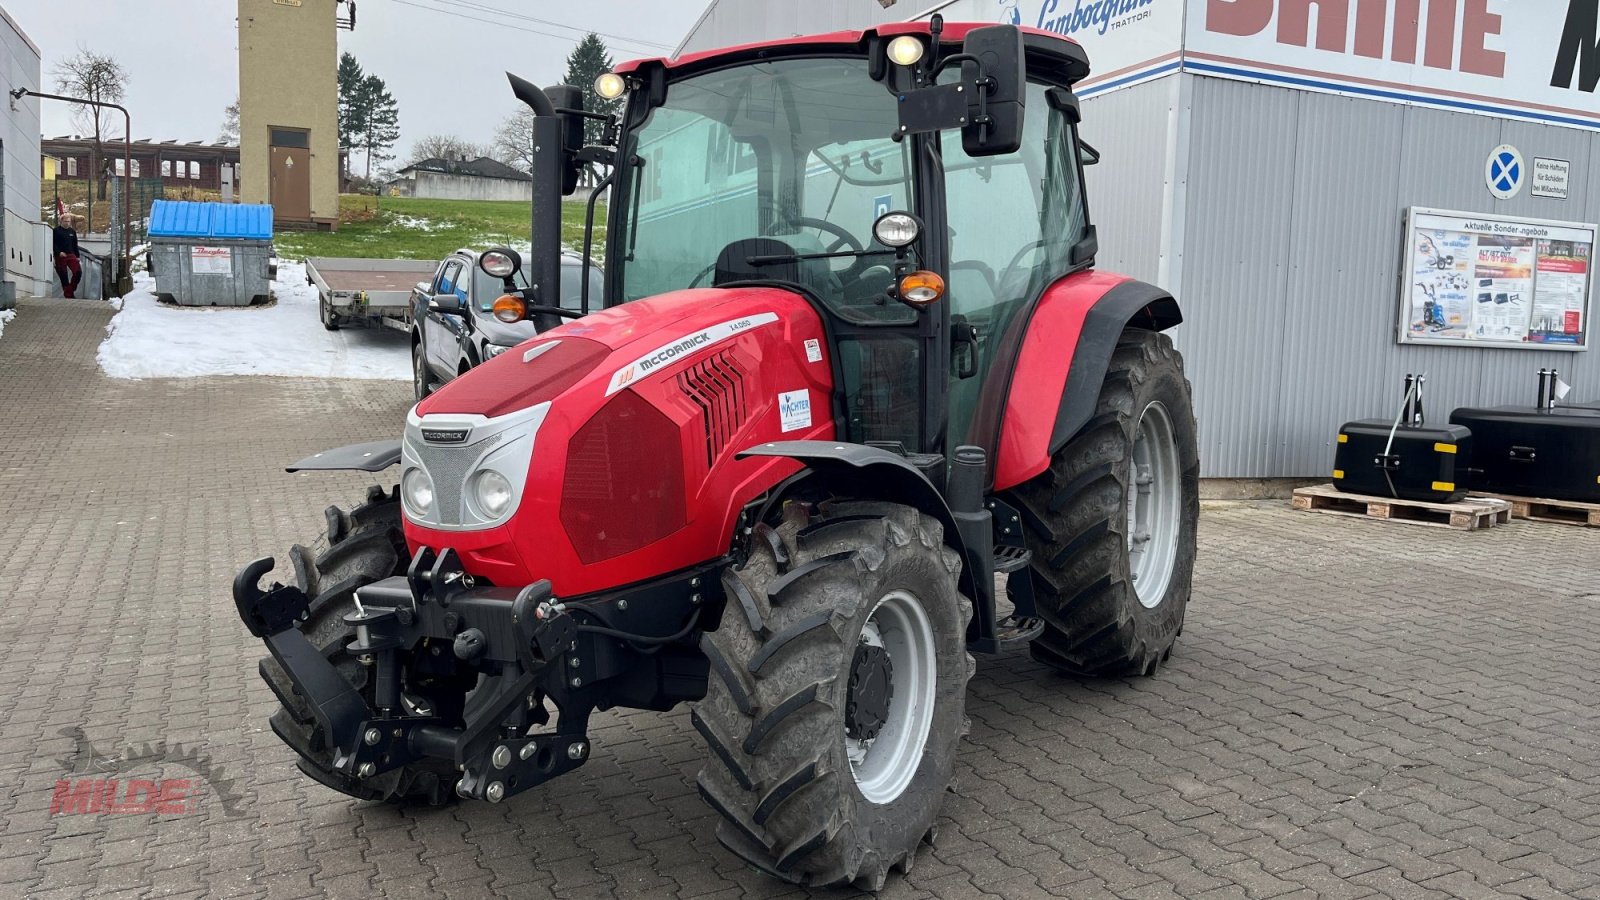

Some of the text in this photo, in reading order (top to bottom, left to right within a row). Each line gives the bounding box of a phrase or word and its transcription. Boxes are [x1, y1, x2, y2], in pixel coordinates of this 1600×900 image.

[1037, 0, 1152, 36] Lamborghin
[1111, 10, 1152, 31] TRATTORI
[1536, 162, 1567, 173] Keine Haftung
[1545, 174, 1564, 182] Schäden
[1464, 221, 1549, 236] Aktuelle Sonderngebote
